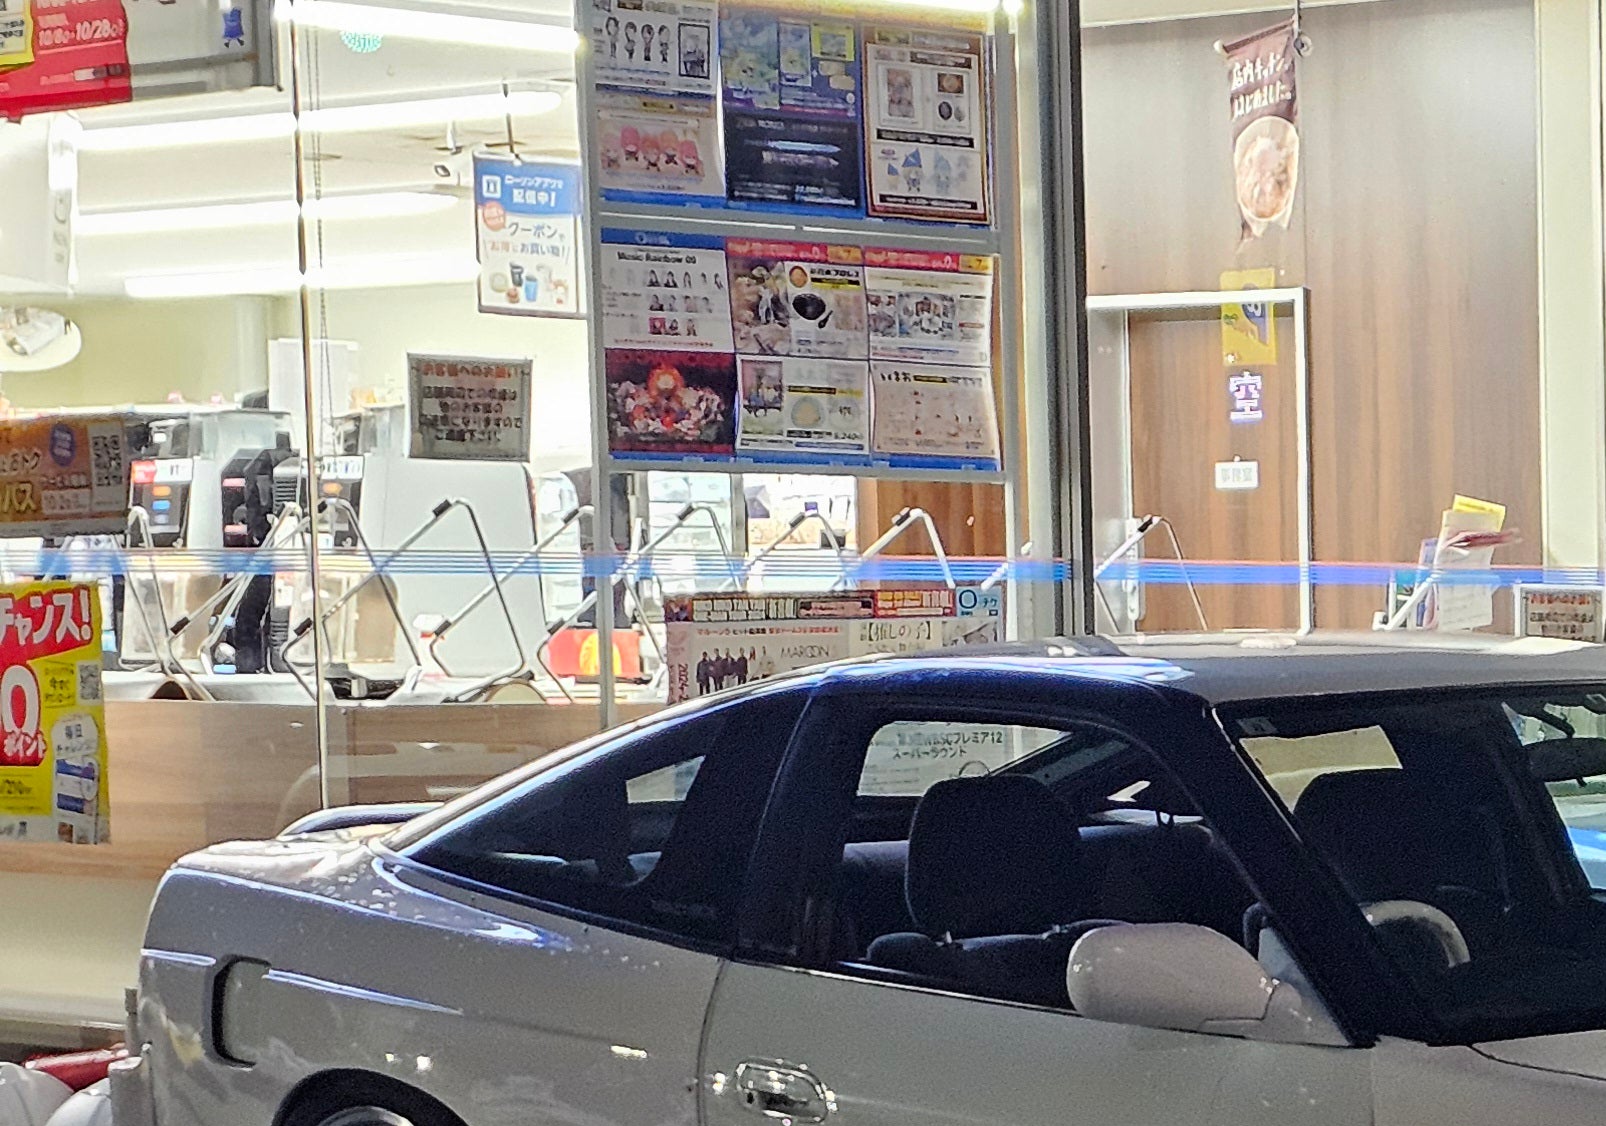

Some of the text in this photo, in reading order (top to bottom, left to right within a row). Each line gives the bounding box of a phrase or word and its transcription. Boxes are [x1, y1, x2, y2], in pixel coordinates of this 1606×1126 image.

[1229, 371, 1263, 424] 空
[4, 732, 47, 759] ポイント
